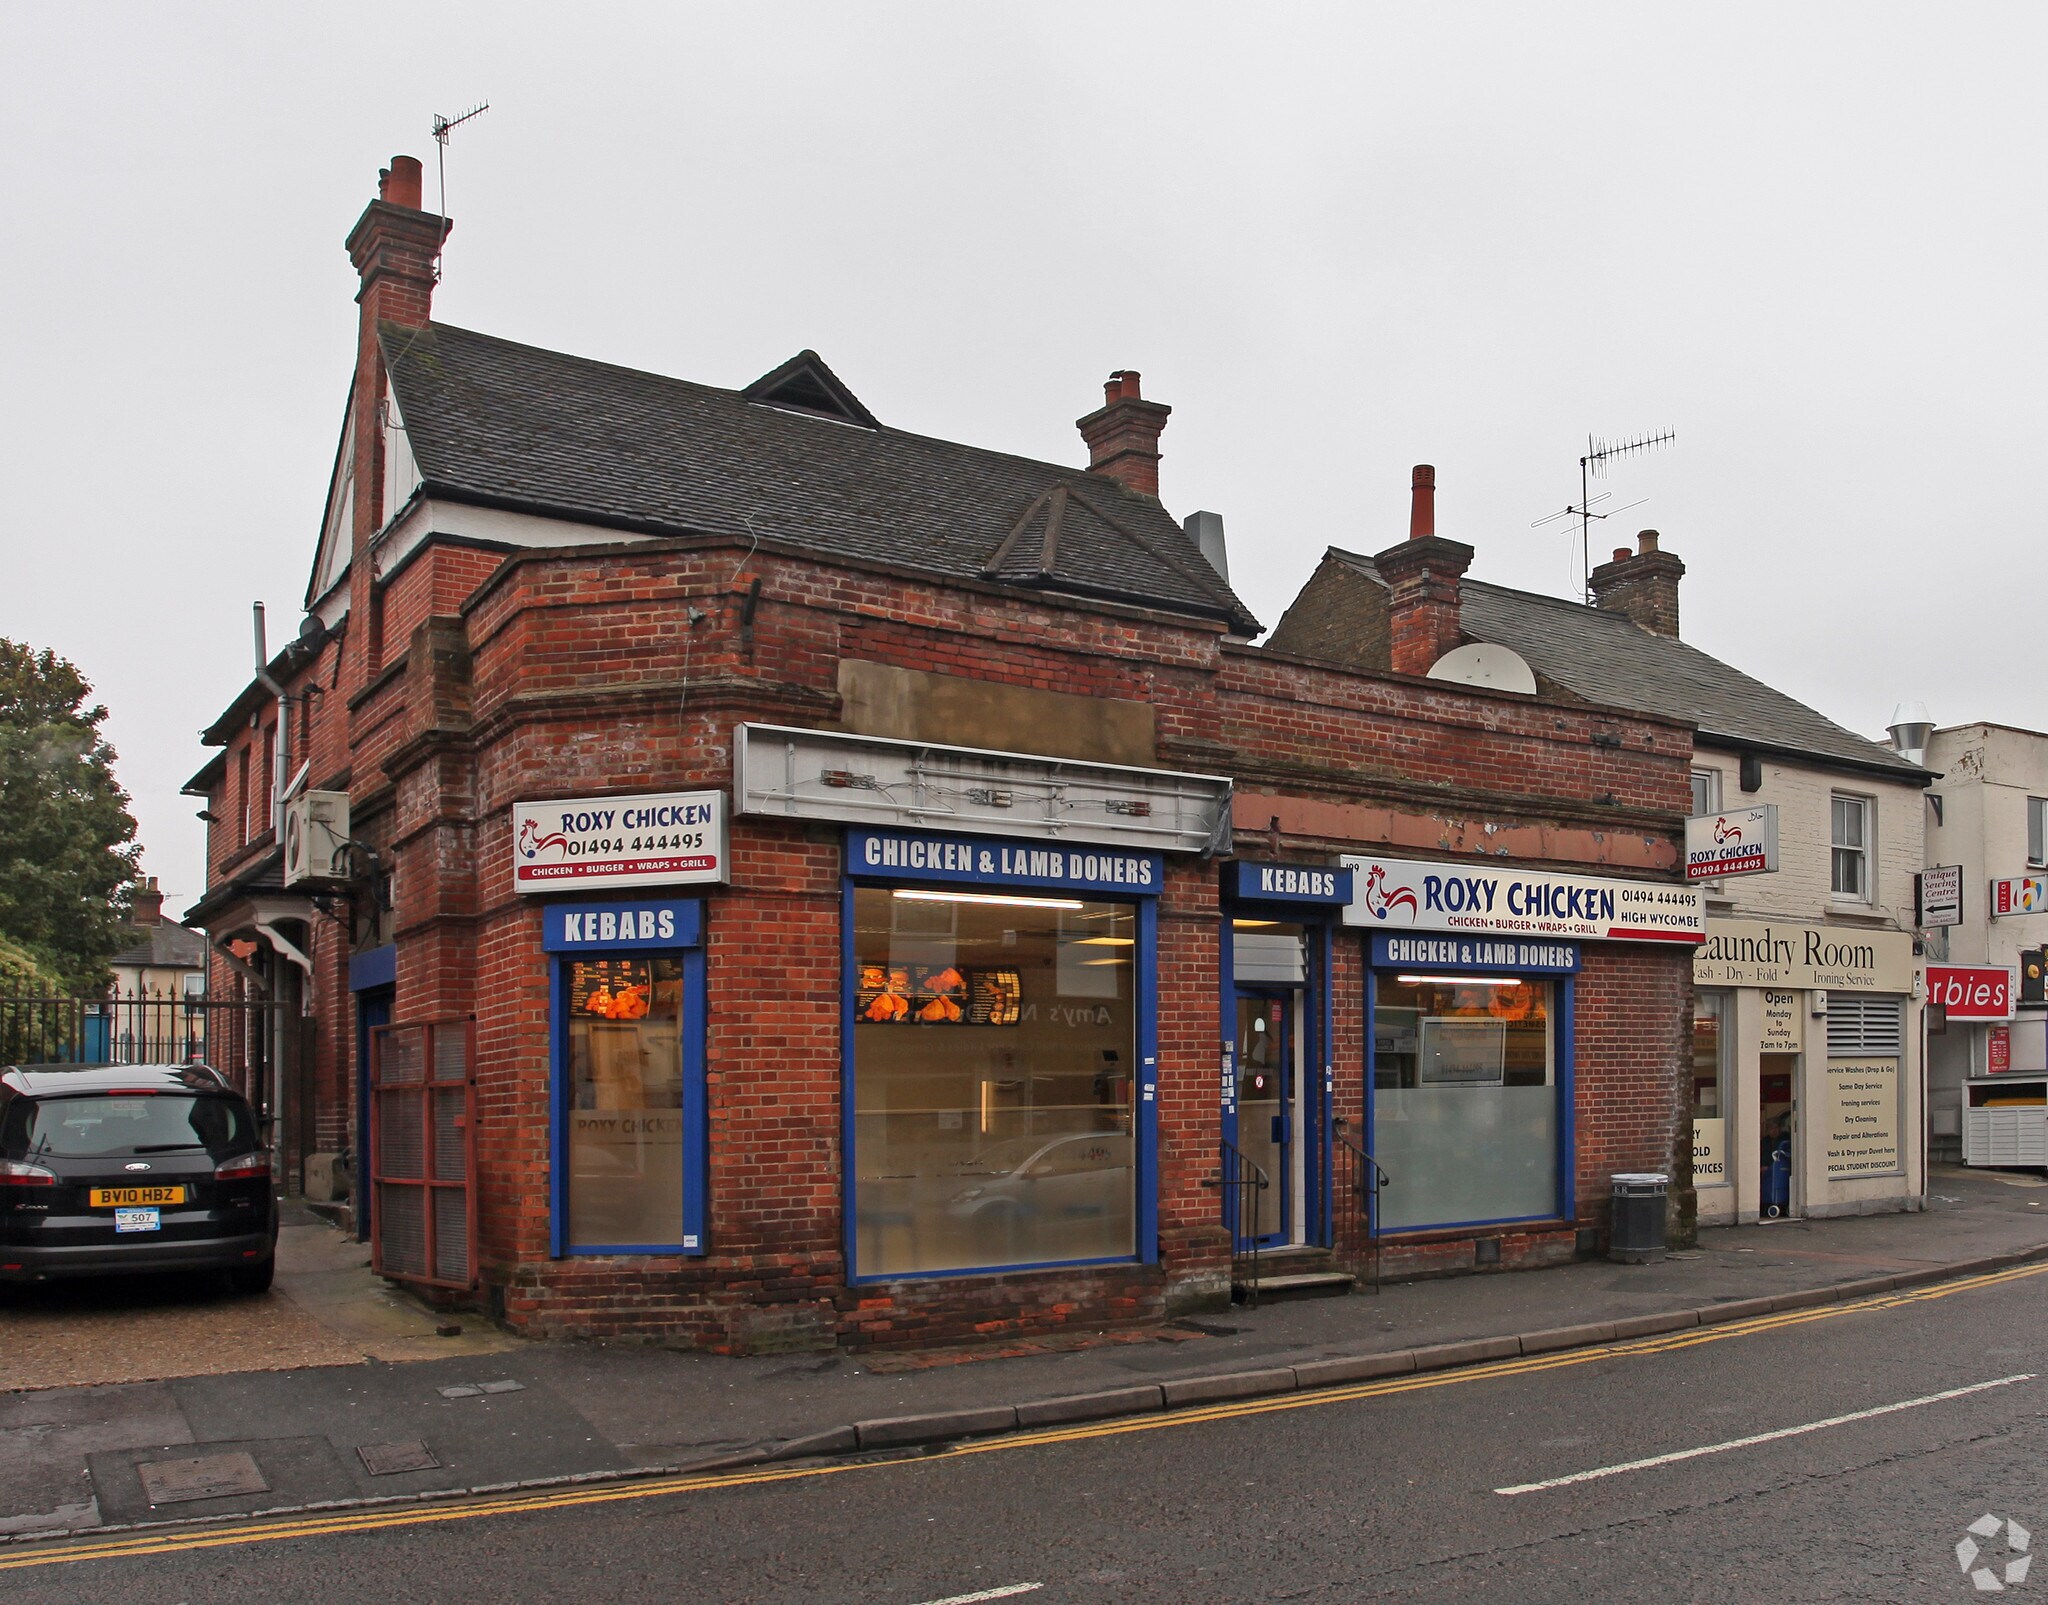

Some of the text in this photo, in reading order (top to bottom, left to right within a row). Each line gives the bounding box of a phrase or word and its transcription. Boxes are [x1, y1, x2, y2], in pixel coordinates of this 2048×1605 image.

[561, 803, 711, 833] ROXY CHICKEN
[568, 833, 703, 855] 01494 444495
[865, 837, 1152, 885] CHICKEN & LAMB DONERS
[1690, 843, 1762, 864] ROXY CHICKEN
[532, 859, 707, 876] CHICKEN BURGER WRAPS GRILL
[1691, 859, 1761, 876] 01494 444495
[1924, 871, 1957, 880] Unique
[1261, 868, 1335, 896] KEBABS
[1924, 880, 1957, 889] Sewing
[1424, 875, 1616, 921] ROXY CHICKEN
[1622, 889, 1696, 907] 01494 444495
[1925, 889, 1956, 898] Centre
[565, 910, 675, 942] KEBABS
[1447, 915, 1597, 934] CHICKEN BURGER WRAPS GRILL
[1621, 912, 1699, 927] HIGH WYCOMBE
[1387, 939, 1574, 967] CHICKEN & LAMB DONERS
[1803, 930, 1874, 969] Room
[1726, 967, 1745, 983] Dry
[1756, 968, 1778, 982] Fold
[1813, 970, 1875, 988] Ironing Service
[1765, 991, 1793, 1007] Open
[1766, 1010, 1792, 1020] Monday
[1767, 1028, 1791, 1038] Sunday
[1760, 1041, 1775, 1049] 7am
[1784, 1041, 1798, 1050] 7pm
[1865, 1066, 1879, 1074] (Drop
[1845, 1115, 1877, 1124] Dry Cleaning
[1833, 1133, 1850, 1141] Repair
[1862, 1131, 1888, 1139] Alterations
[1847, 1149, 1855, 1157] Dry
[1856, 1149, 1868, 1157] your
[101, 1188, 174, 1204] BV10 HBZ
[132, 1214, 151, 1222] 507
